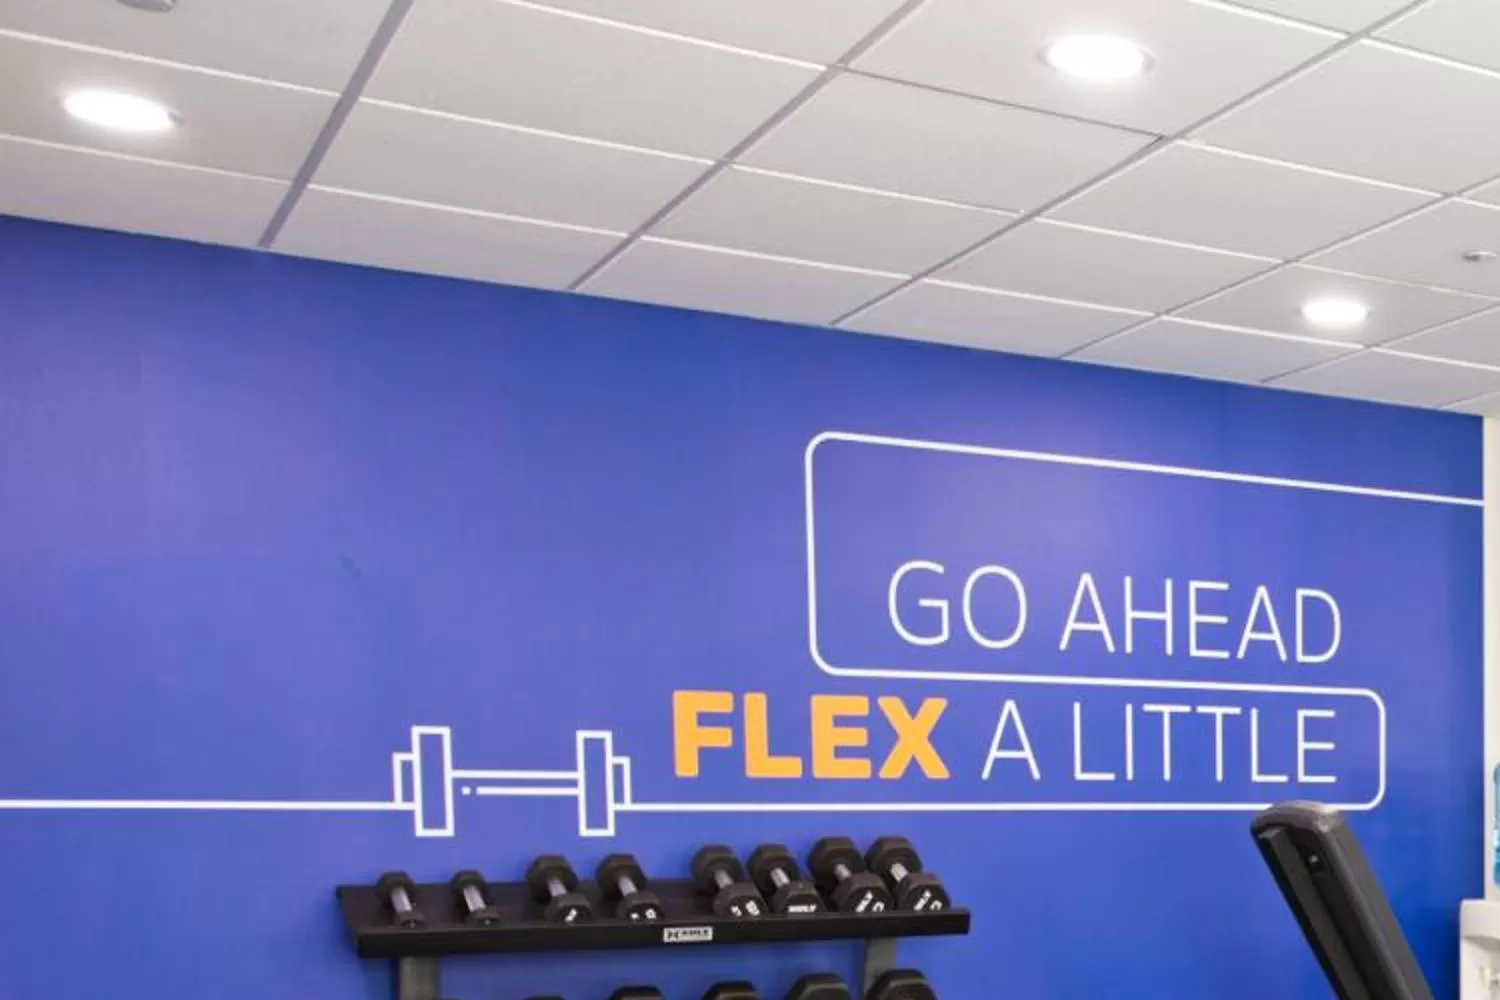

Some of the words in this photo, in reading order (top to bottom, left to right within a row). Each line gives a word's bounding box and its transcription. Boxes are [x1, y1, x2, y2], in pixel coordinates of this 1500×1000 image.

[887, 559, 1028, 651] GO
[1059, 572, 1342, 665] AHEAD
[672, 689, 950, 782] FLEX
[981, 699, 1042, 783] A
[1072, 700, 1338, 785] LITTLE
